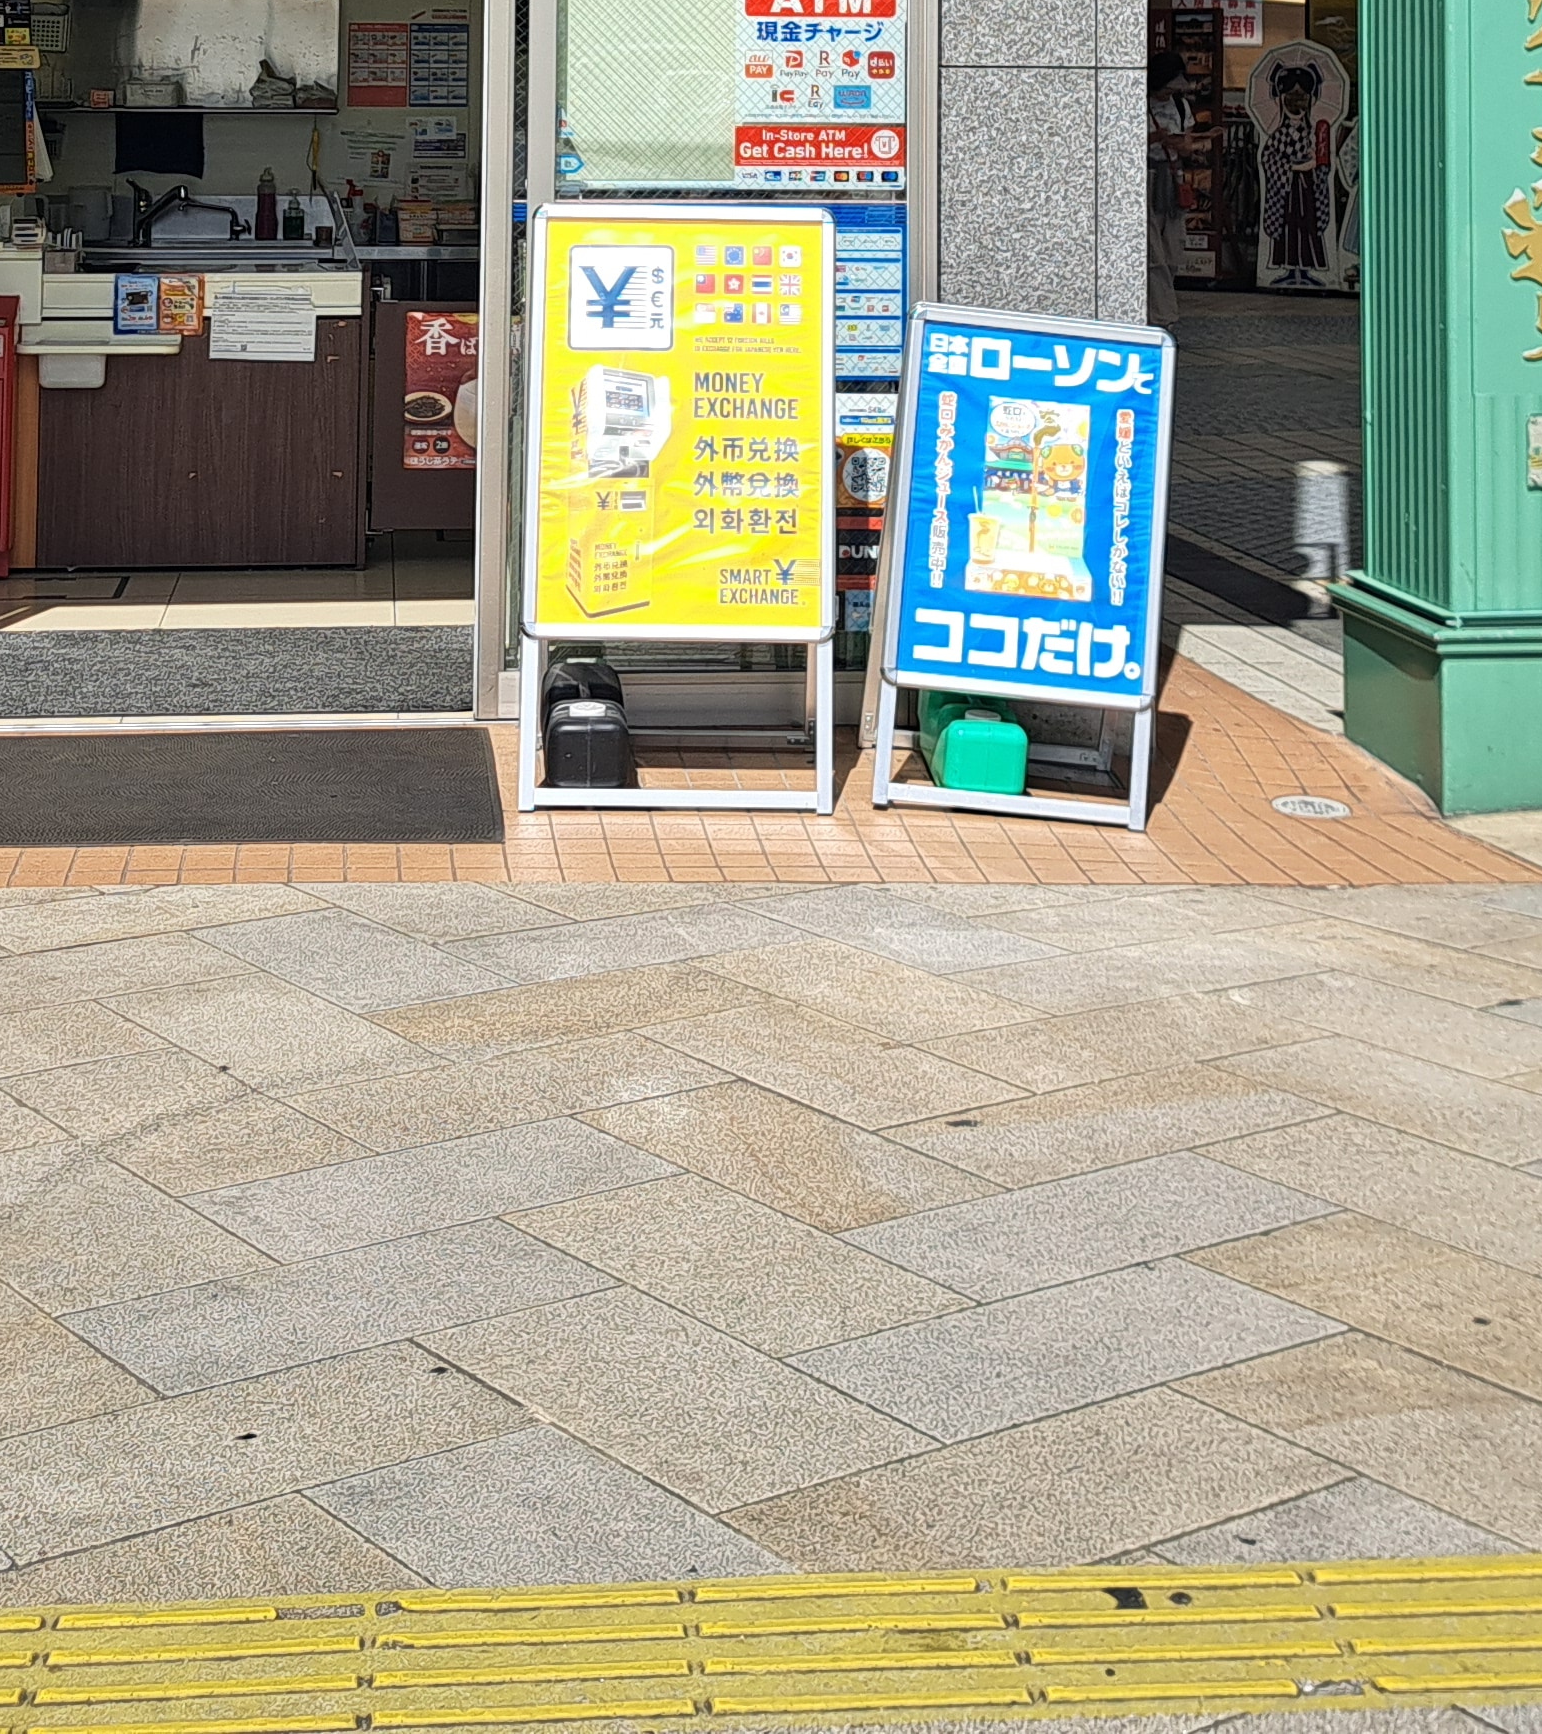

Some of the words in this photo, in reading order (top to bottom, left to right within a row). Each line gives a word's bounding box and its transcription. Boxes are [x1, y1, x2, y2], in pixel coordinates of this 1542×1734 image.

[757, 21, 884, 42] 現金チャージ
[749, 65, 769, 75] PAY
[816, 70, 835, 79] Pay
[842, 69, 860, 80] Pay
[762, 130, 814, 141] In-Store
[818, 130, 845, 141] ATM
[739, 142, 769, 158] Get
[773, 142, 815, 158] Cash
[821, 143, 868, 158] Here!
[694, 372, 764, 393] MONEY
[694, 398, 799, 419] EXCHANGE
[693, 436, 800, 462] 外币兑换
[693, 508, 799, 535] 외화환전
[719, 569, 772, 585] SMART
[719, 588, 799, 605] EXCHANGE
[913, 607, 1141, 680] ココだけ。
